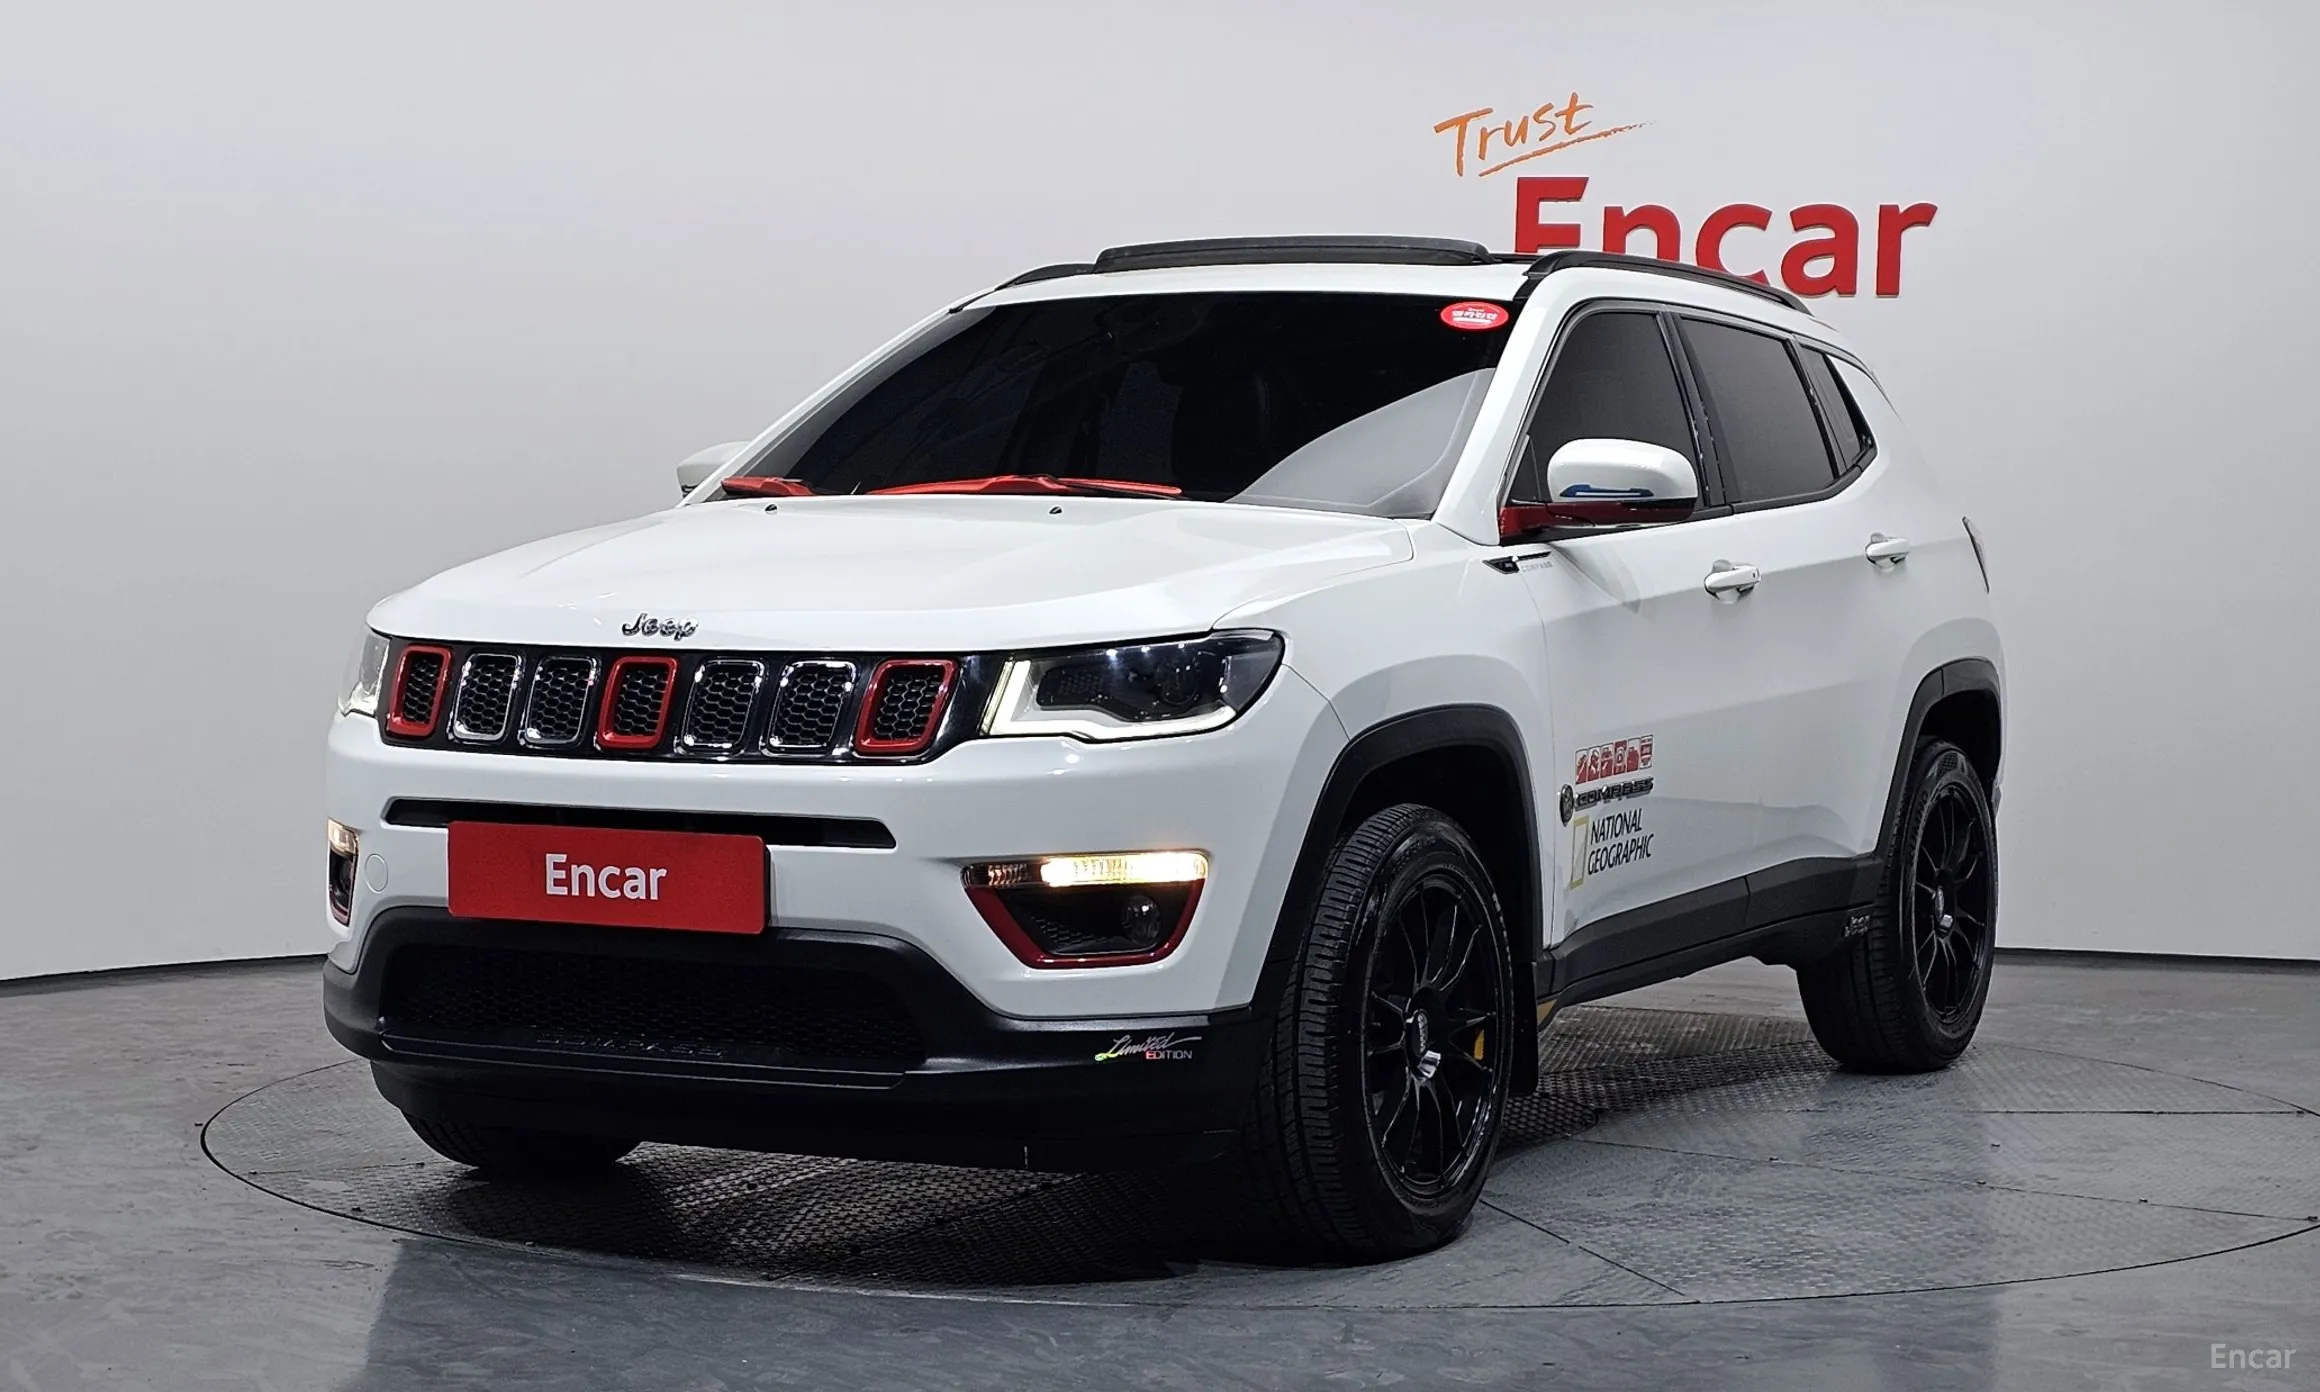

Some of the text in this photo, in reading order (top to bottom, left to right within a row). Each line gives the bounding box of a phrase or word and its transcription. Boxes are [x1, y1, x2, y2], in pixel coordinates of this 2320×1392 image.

[1434, 91, 1594, 177] Trust
[1514, 177, 1938, 298] Encar
[621, 612, 699, 642] Jeep
[1574, 777, 1655, 811] COMPASS
[1590, 808, 1643, 846] NATIONAL
[1587, 834, 1655, 876] GEOGRAPHIC
[545, 852, 668, 901] Encar
[1094, 1032, 1202, 1062] Limited
[1145, 1049, 1193, 1060] EDITION
